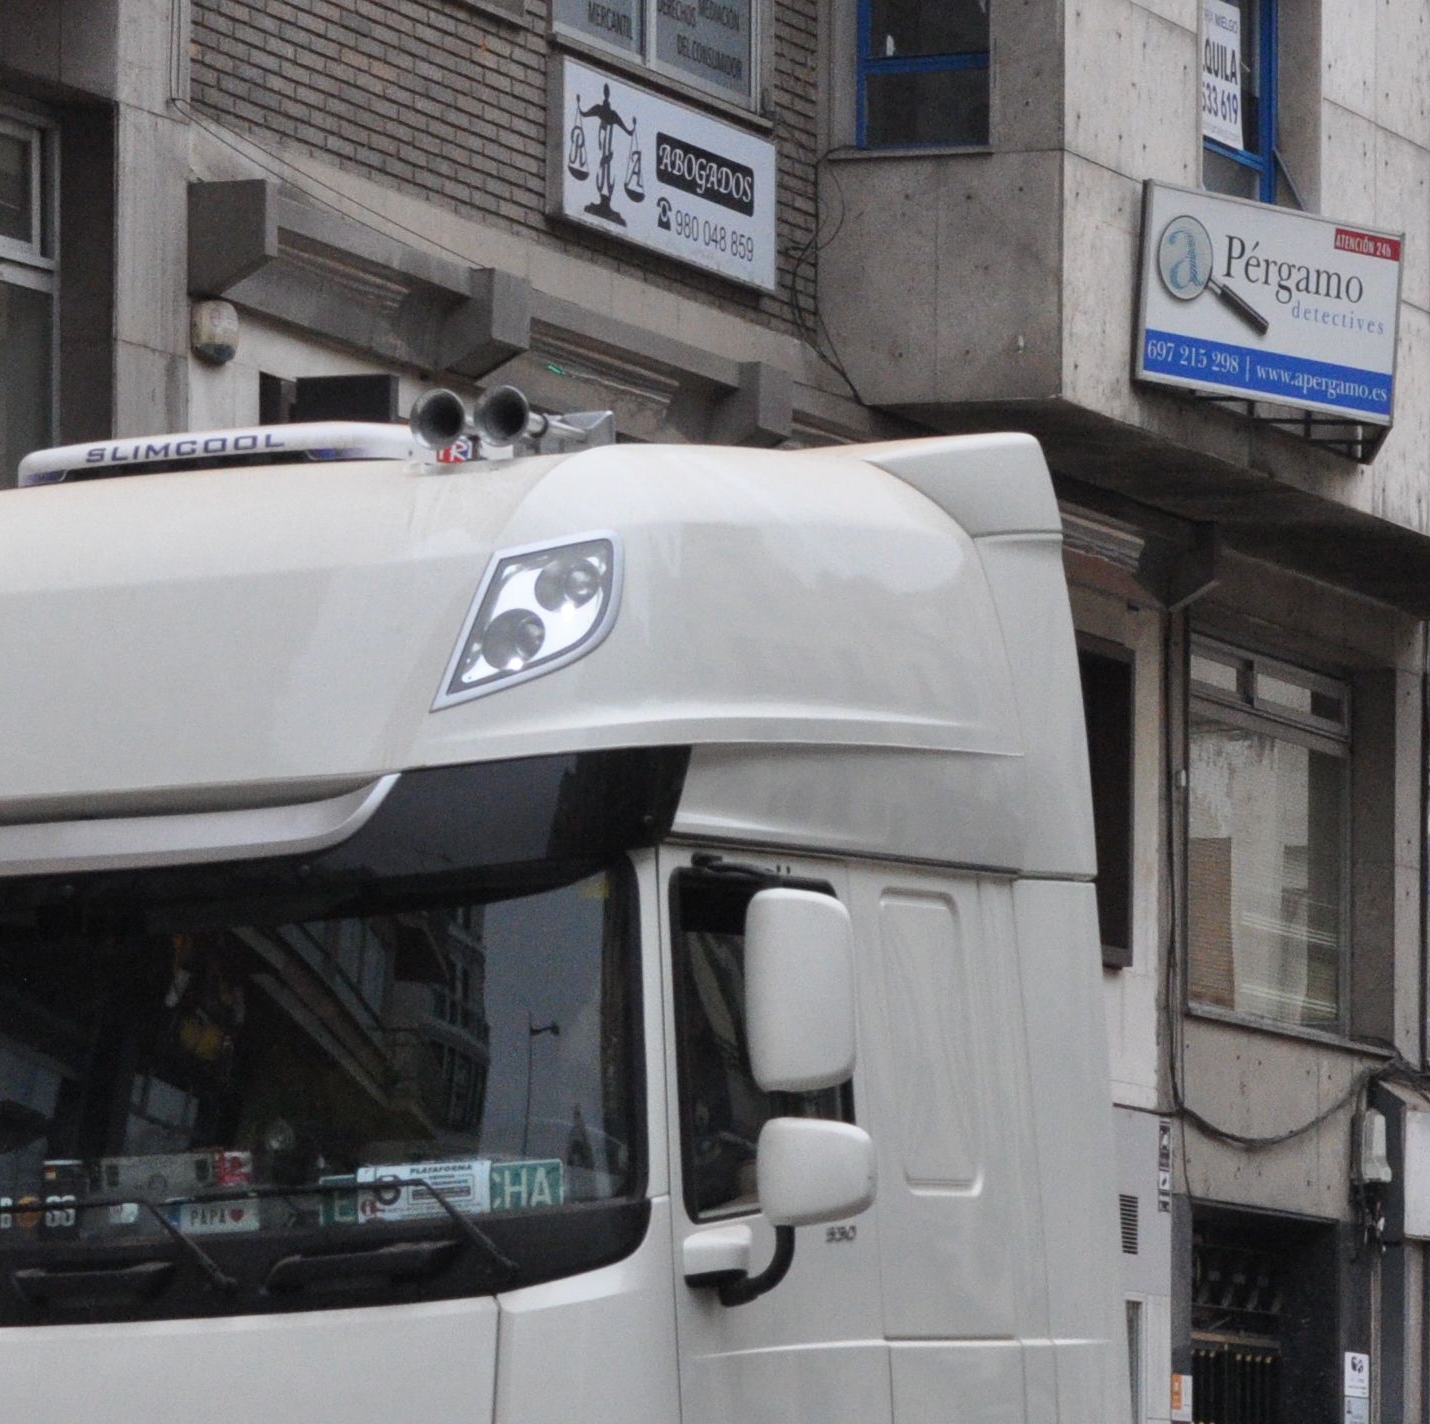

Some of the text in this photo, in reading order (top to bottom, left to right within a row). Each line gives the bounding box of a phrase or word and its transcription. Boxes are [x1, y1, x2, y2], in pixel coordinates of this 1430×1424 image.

[1202, 37, 1238, 86] QUILA
[1220, 89, 1238, 125] 619
[658, 143, 753, 204] ABOGADOS
[675, 210, 754, 262] 980 048 859
[1335, 231, 1391, 257] ATENCIÓN 24h
[1222, 234, 1364, 304] Pérgamo
[1291, 301, 1385, 335] detectives
[1147, 339, 1388, 401] 697 215 298 www.apergamo.es
[85, 433, 286, 464] SLIMCOOL
